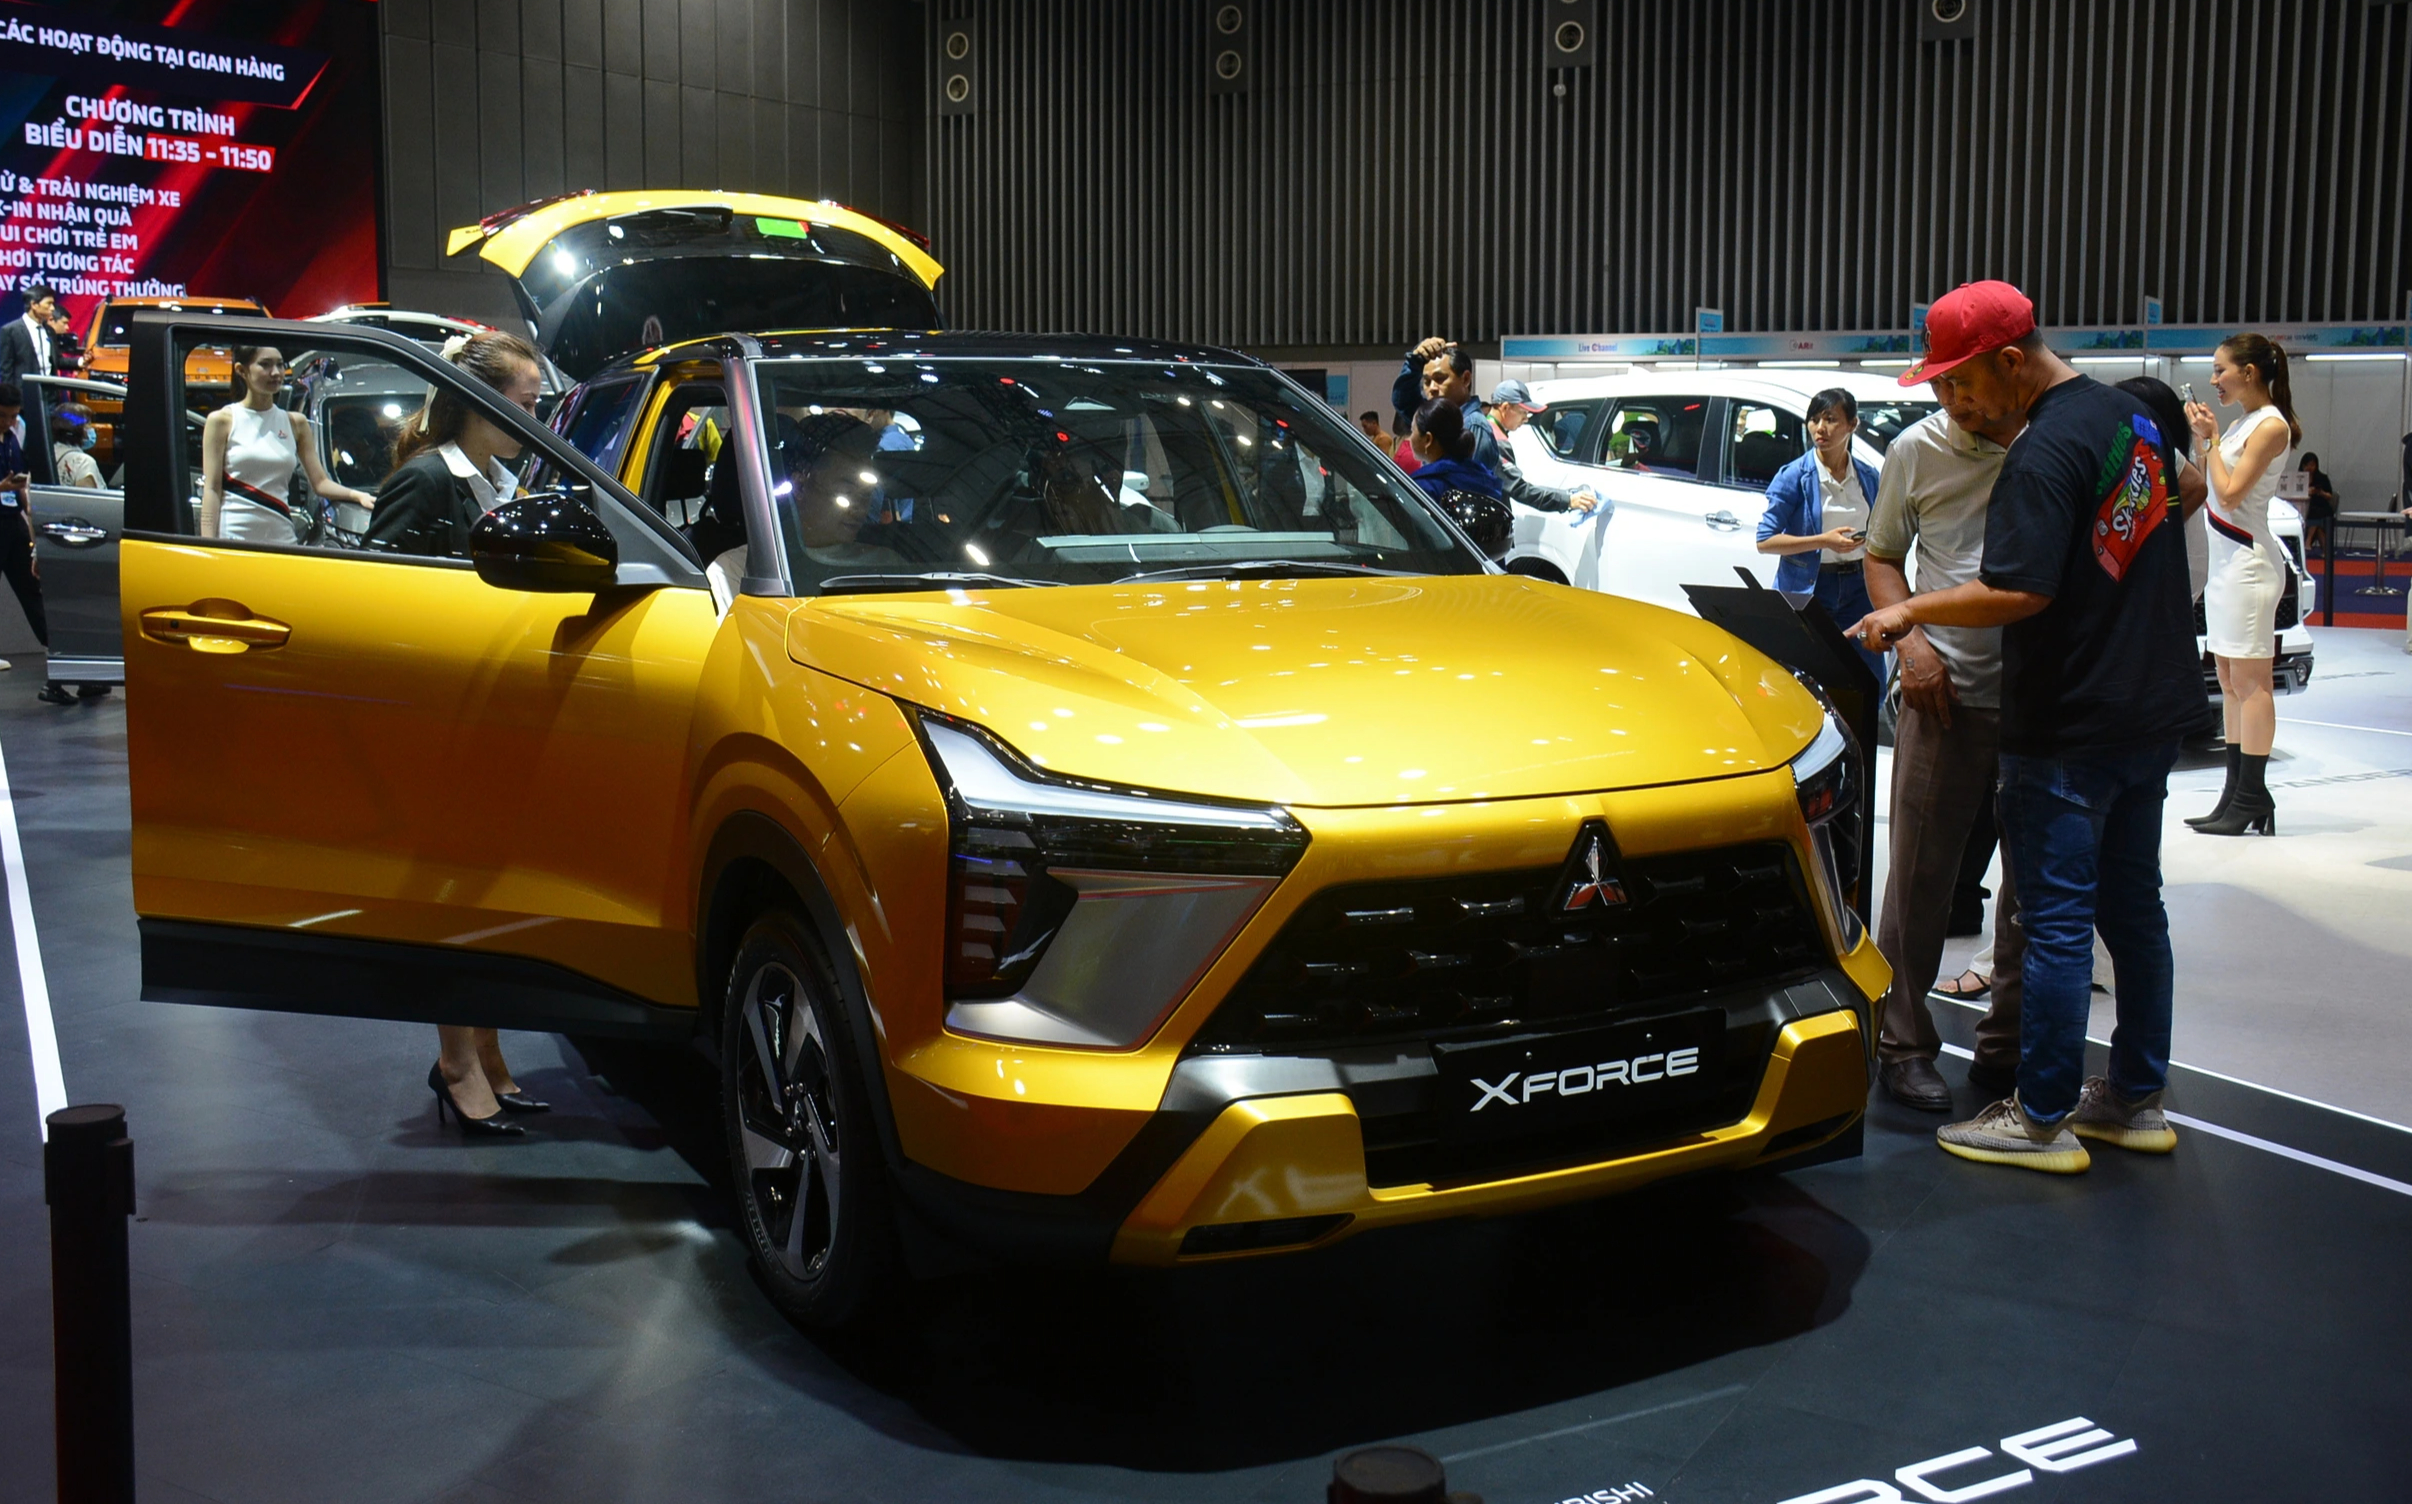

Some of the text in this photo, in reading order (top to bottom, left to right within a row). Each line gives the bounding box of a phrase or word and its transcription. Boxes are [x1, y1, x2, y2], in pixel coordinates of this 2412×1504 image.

[39, 27, 94, 55] HOẠT
[96, 34, 152, 61] ĐỘNG
[154, 45, 184, 69] TẠI
[187, 50, 232, 73] GIAN
[235, 56, 285, 81] HÀNG
[65, 95, 235, 136] CHƯƠNG TRÌNH
[25, 116, 83, 149] BIỂU
[88, 124, 144, 157] DIỄN
[146, 137, 201, 163] 11:35
[219, 146, 272, 171] 11:50
[19, 176, 36, 194] &
[36, 175, 81, 198] TRẢI
[84, 183, 155, 207] NGHIỆM
[158, 189, 181, 207] XE
[37, 201, 90, 226] NHẬN
[94, 206, 133, 227] QUÀ
[24, 226, 69, 246] CHƠI
[71, 227, 107, 248] TRẺ
[110, 232, 138, 251] EM
[0, 248, 135, 274] HƠI TƯƠNG TÁC
[46, 274, 110, 296] TRÚNG
[111, 277, 184, 297] THƯỞNG
[1469, 1047, 1699, 1112] XFORCE
